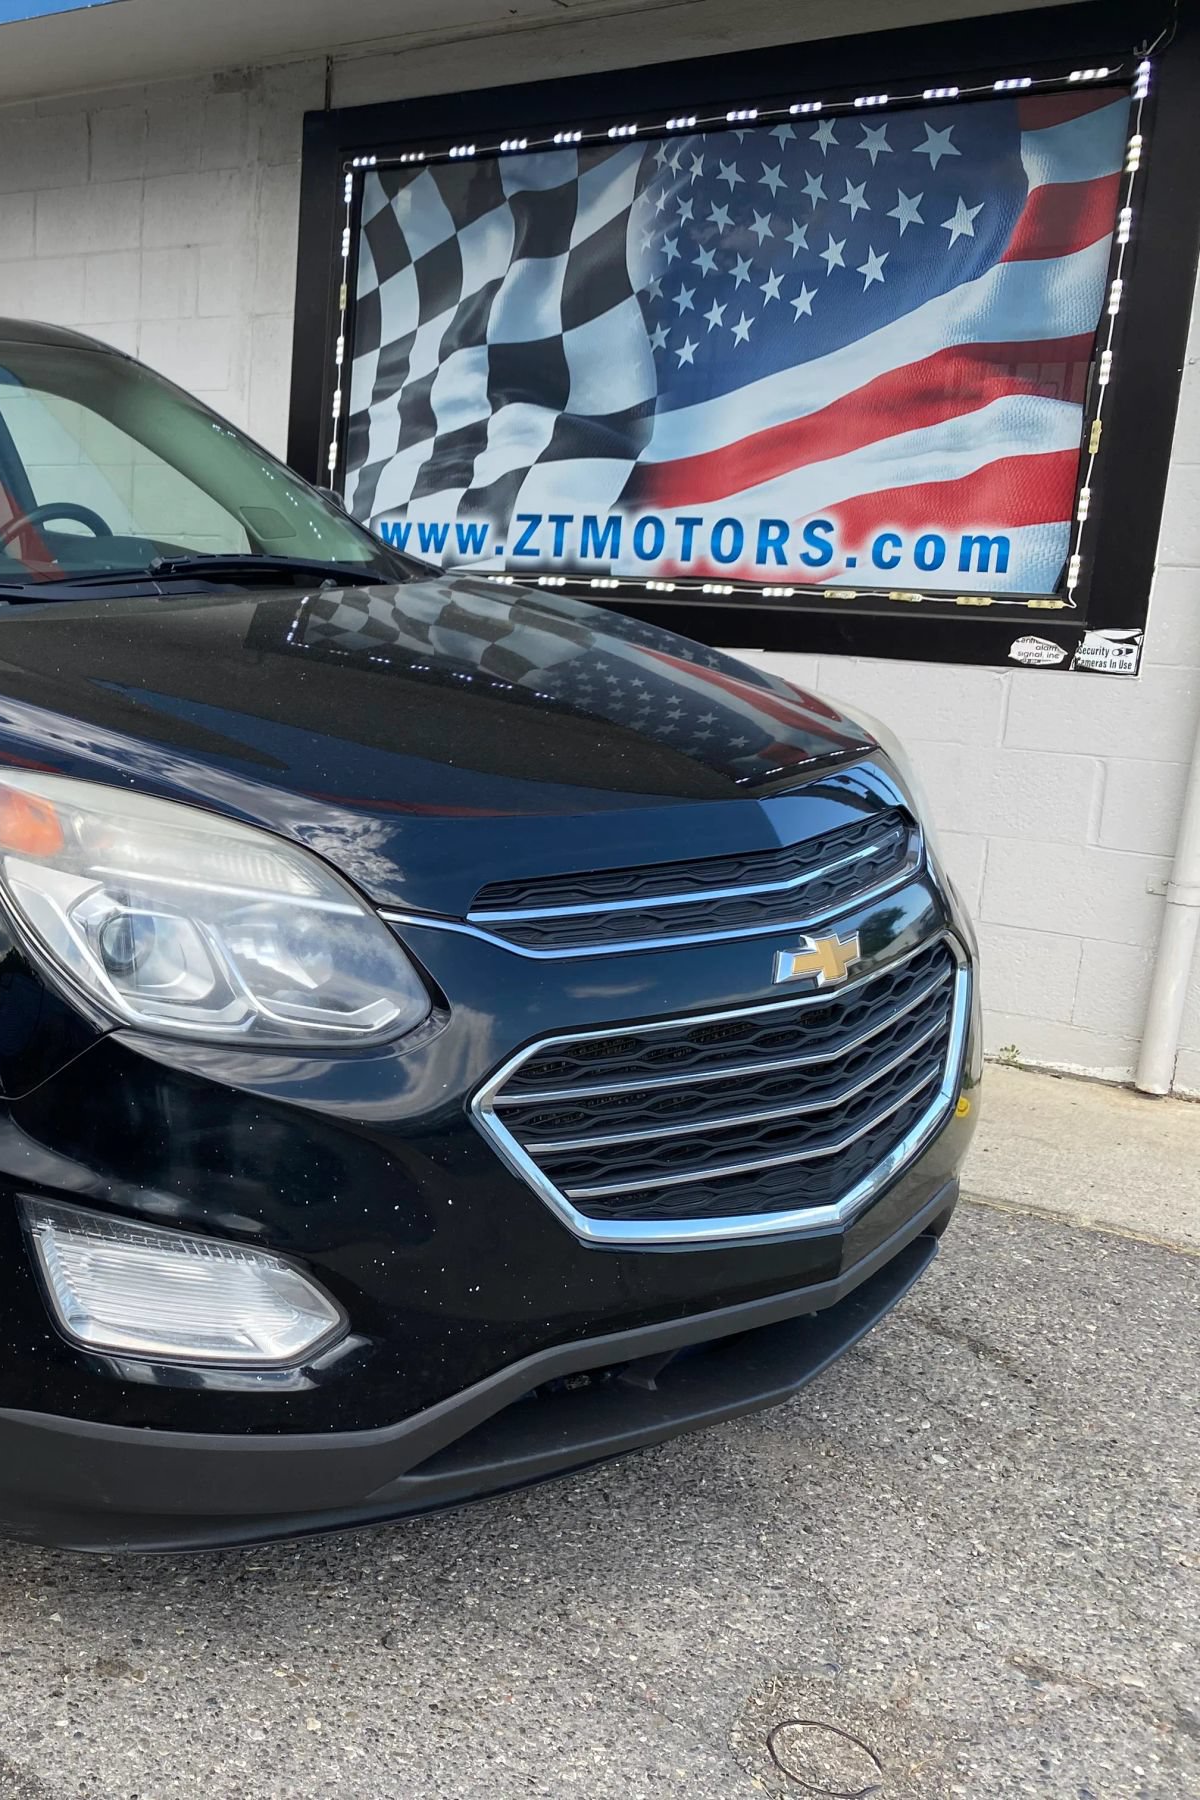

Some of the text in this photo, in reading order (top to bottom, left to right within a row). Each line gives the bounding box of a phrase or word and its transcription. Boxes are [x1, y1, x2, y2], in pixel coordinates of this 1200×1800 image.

[381, 513, 1010, 574] www.ZTMOTORS.com
[1077, 646, 1110, 658] Security
[1110, 659, 1117, 669] In
[1119, 659, 1133, 670] Use
